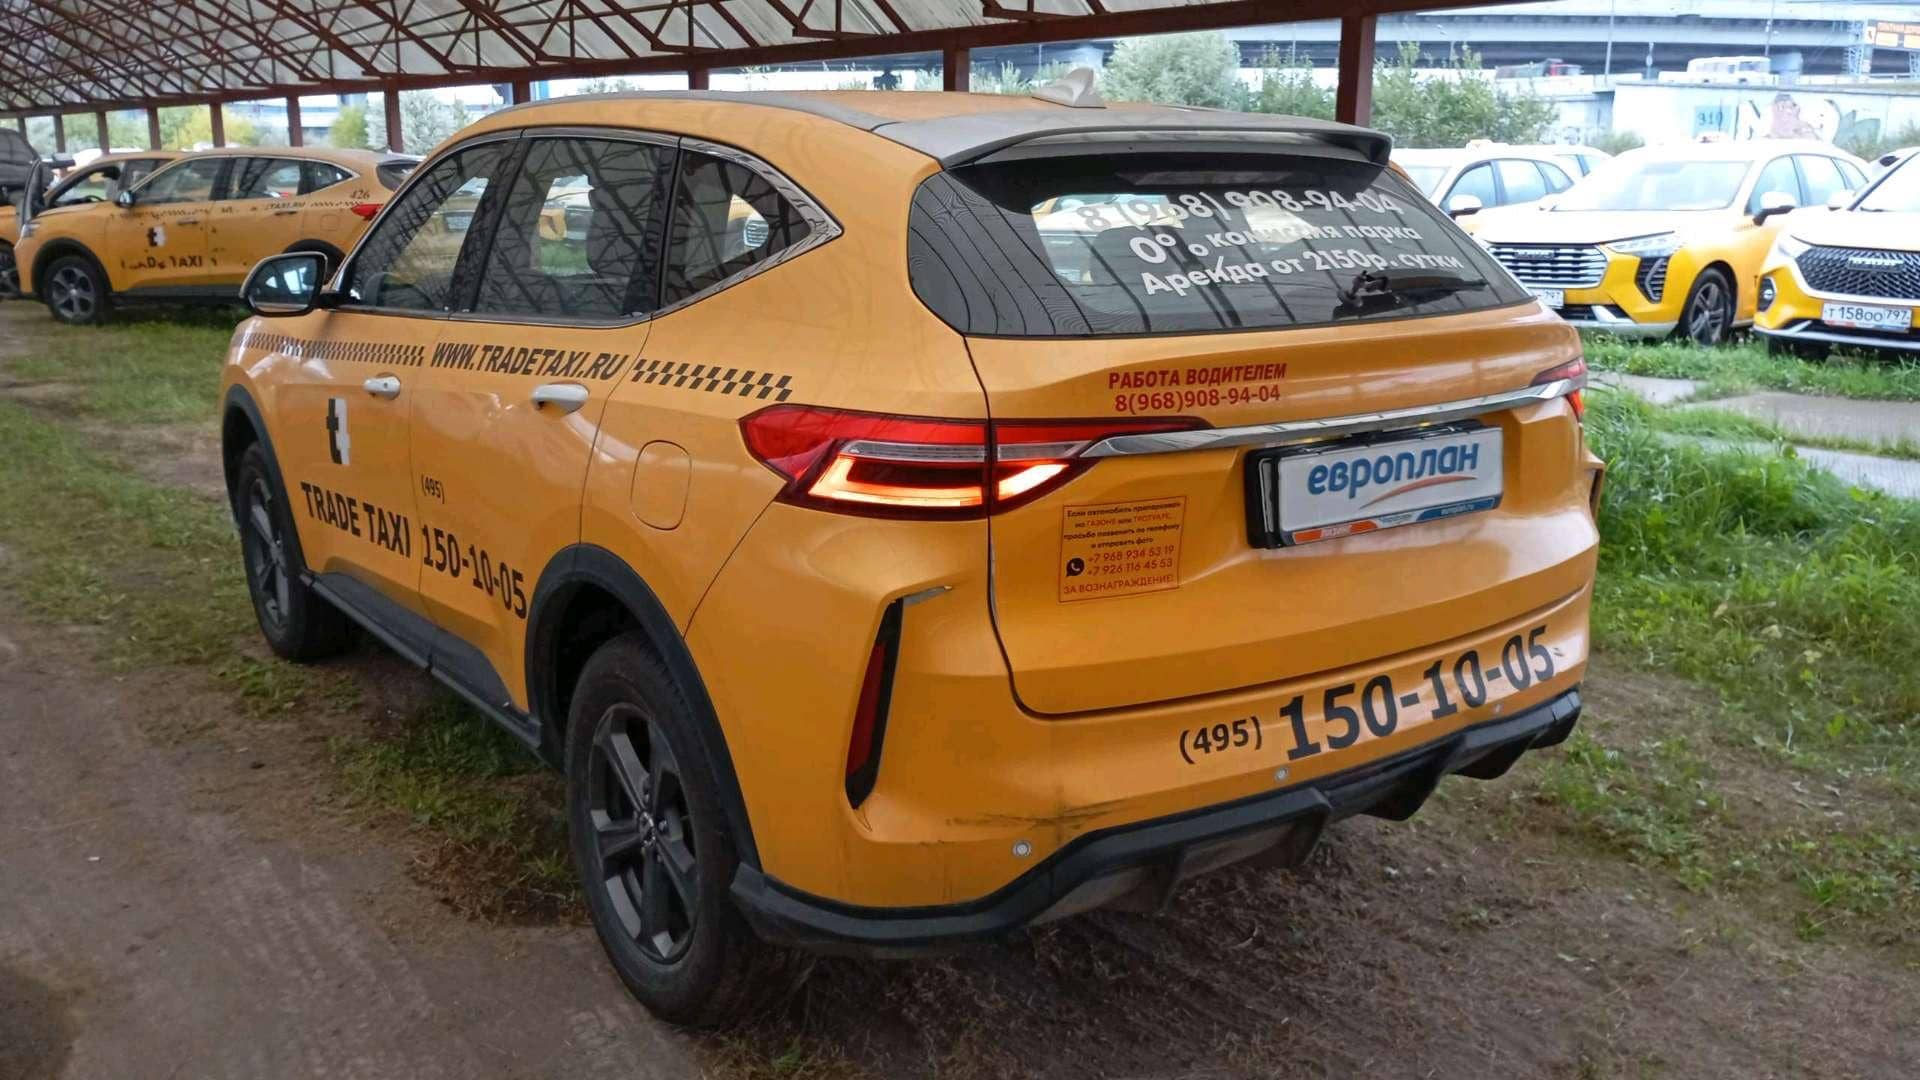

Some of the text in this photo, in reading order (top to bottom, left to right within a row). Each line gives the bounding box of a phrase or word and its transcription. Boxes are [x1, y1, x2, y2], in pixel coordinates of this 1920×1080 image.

[1343, 224, 1424, 244] парка
[1271, 258, 1304, 275] от
[1398, 253, 1465, 270] сутки
[430, 342, 629, 380] WWW.TRADETAXI.RU
[1108, 363, 1287, 389] РАБОТА ВОДИТЕЛЕМ
[1115, 385, 1281, 415] 8(968)908-94-04
[1307, 443, 1479, 499] европлан
[421, 474, 445, 505] (495)
[300, 481, 411, 558] TRADE TAXI
[421, 524, 527, 620] 150-10-05
[1064, 586, 1076, 594] ЗА
[1179, 625, 1555, 765] (495) 150-10-05
